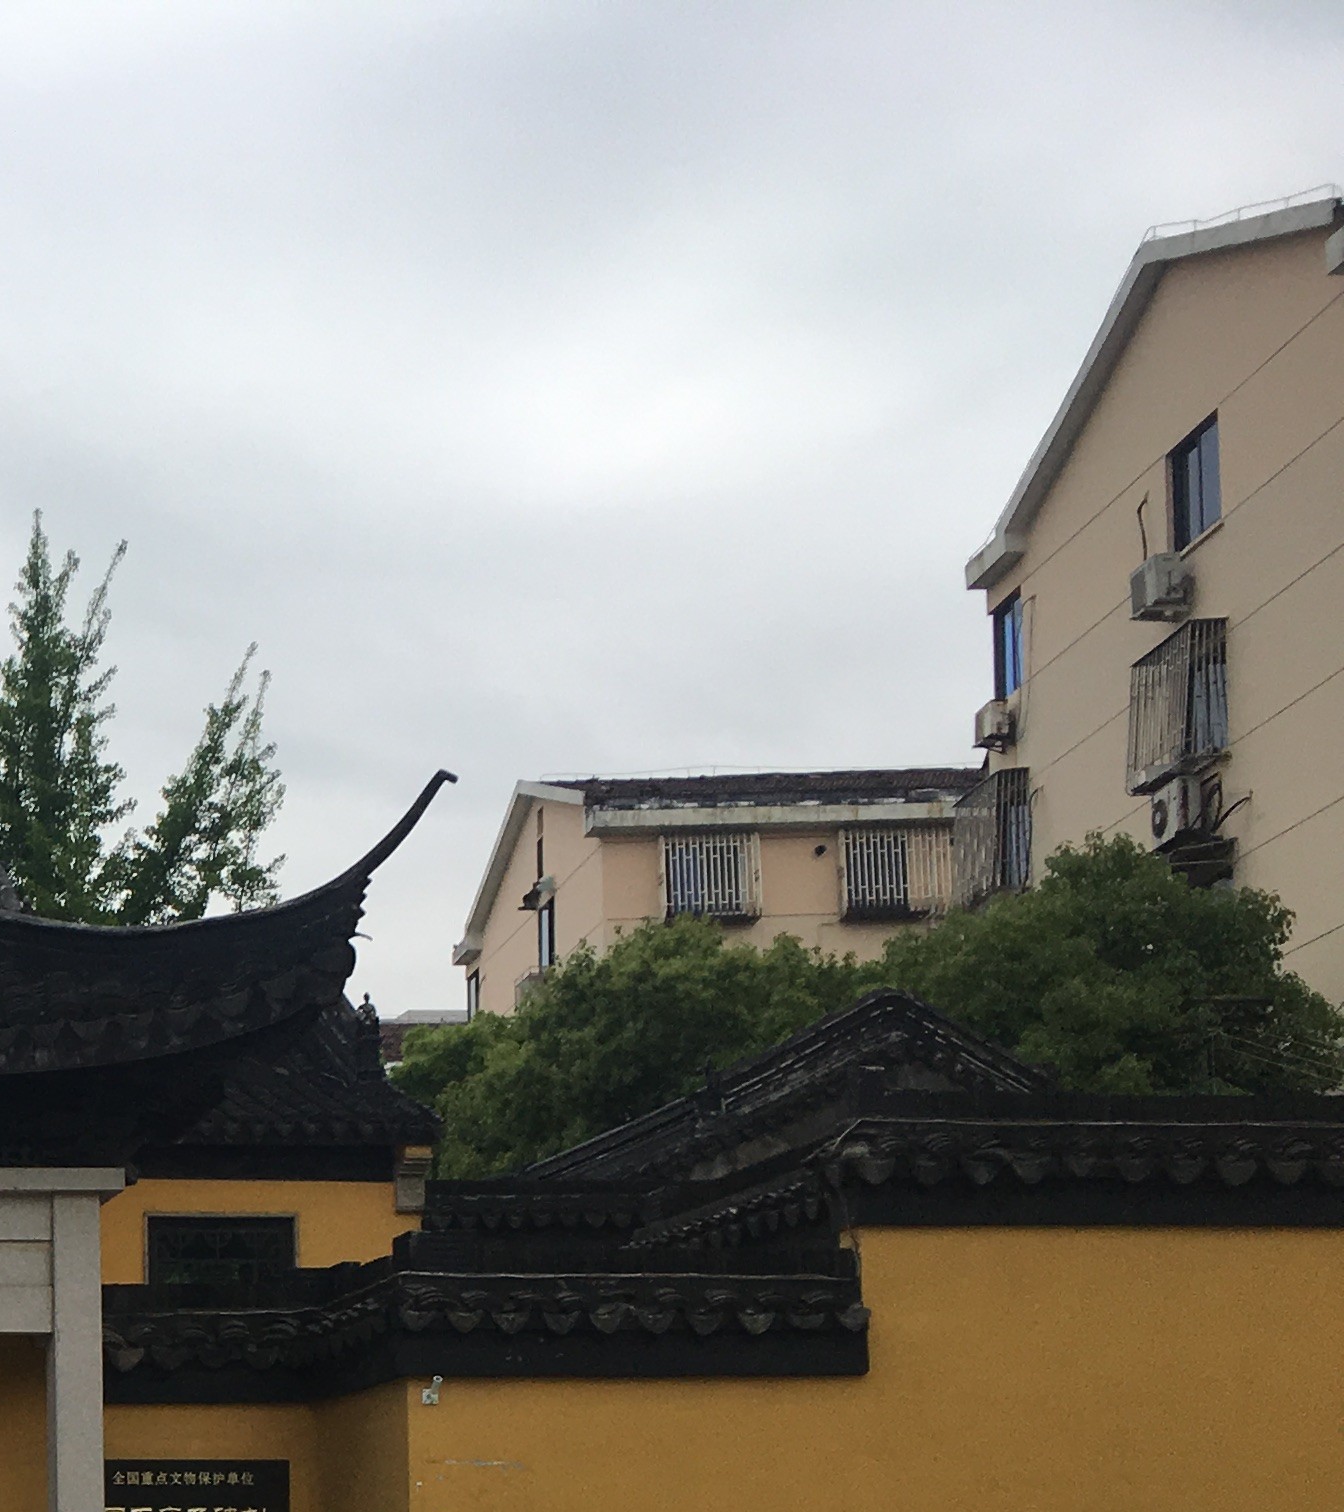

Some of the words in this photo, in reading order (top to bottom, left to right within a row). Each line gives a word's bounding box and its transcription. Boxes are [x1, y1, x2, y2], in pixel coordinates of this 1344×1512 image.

[112, 1471, 255, 1487] 全国重点文物保护单位
